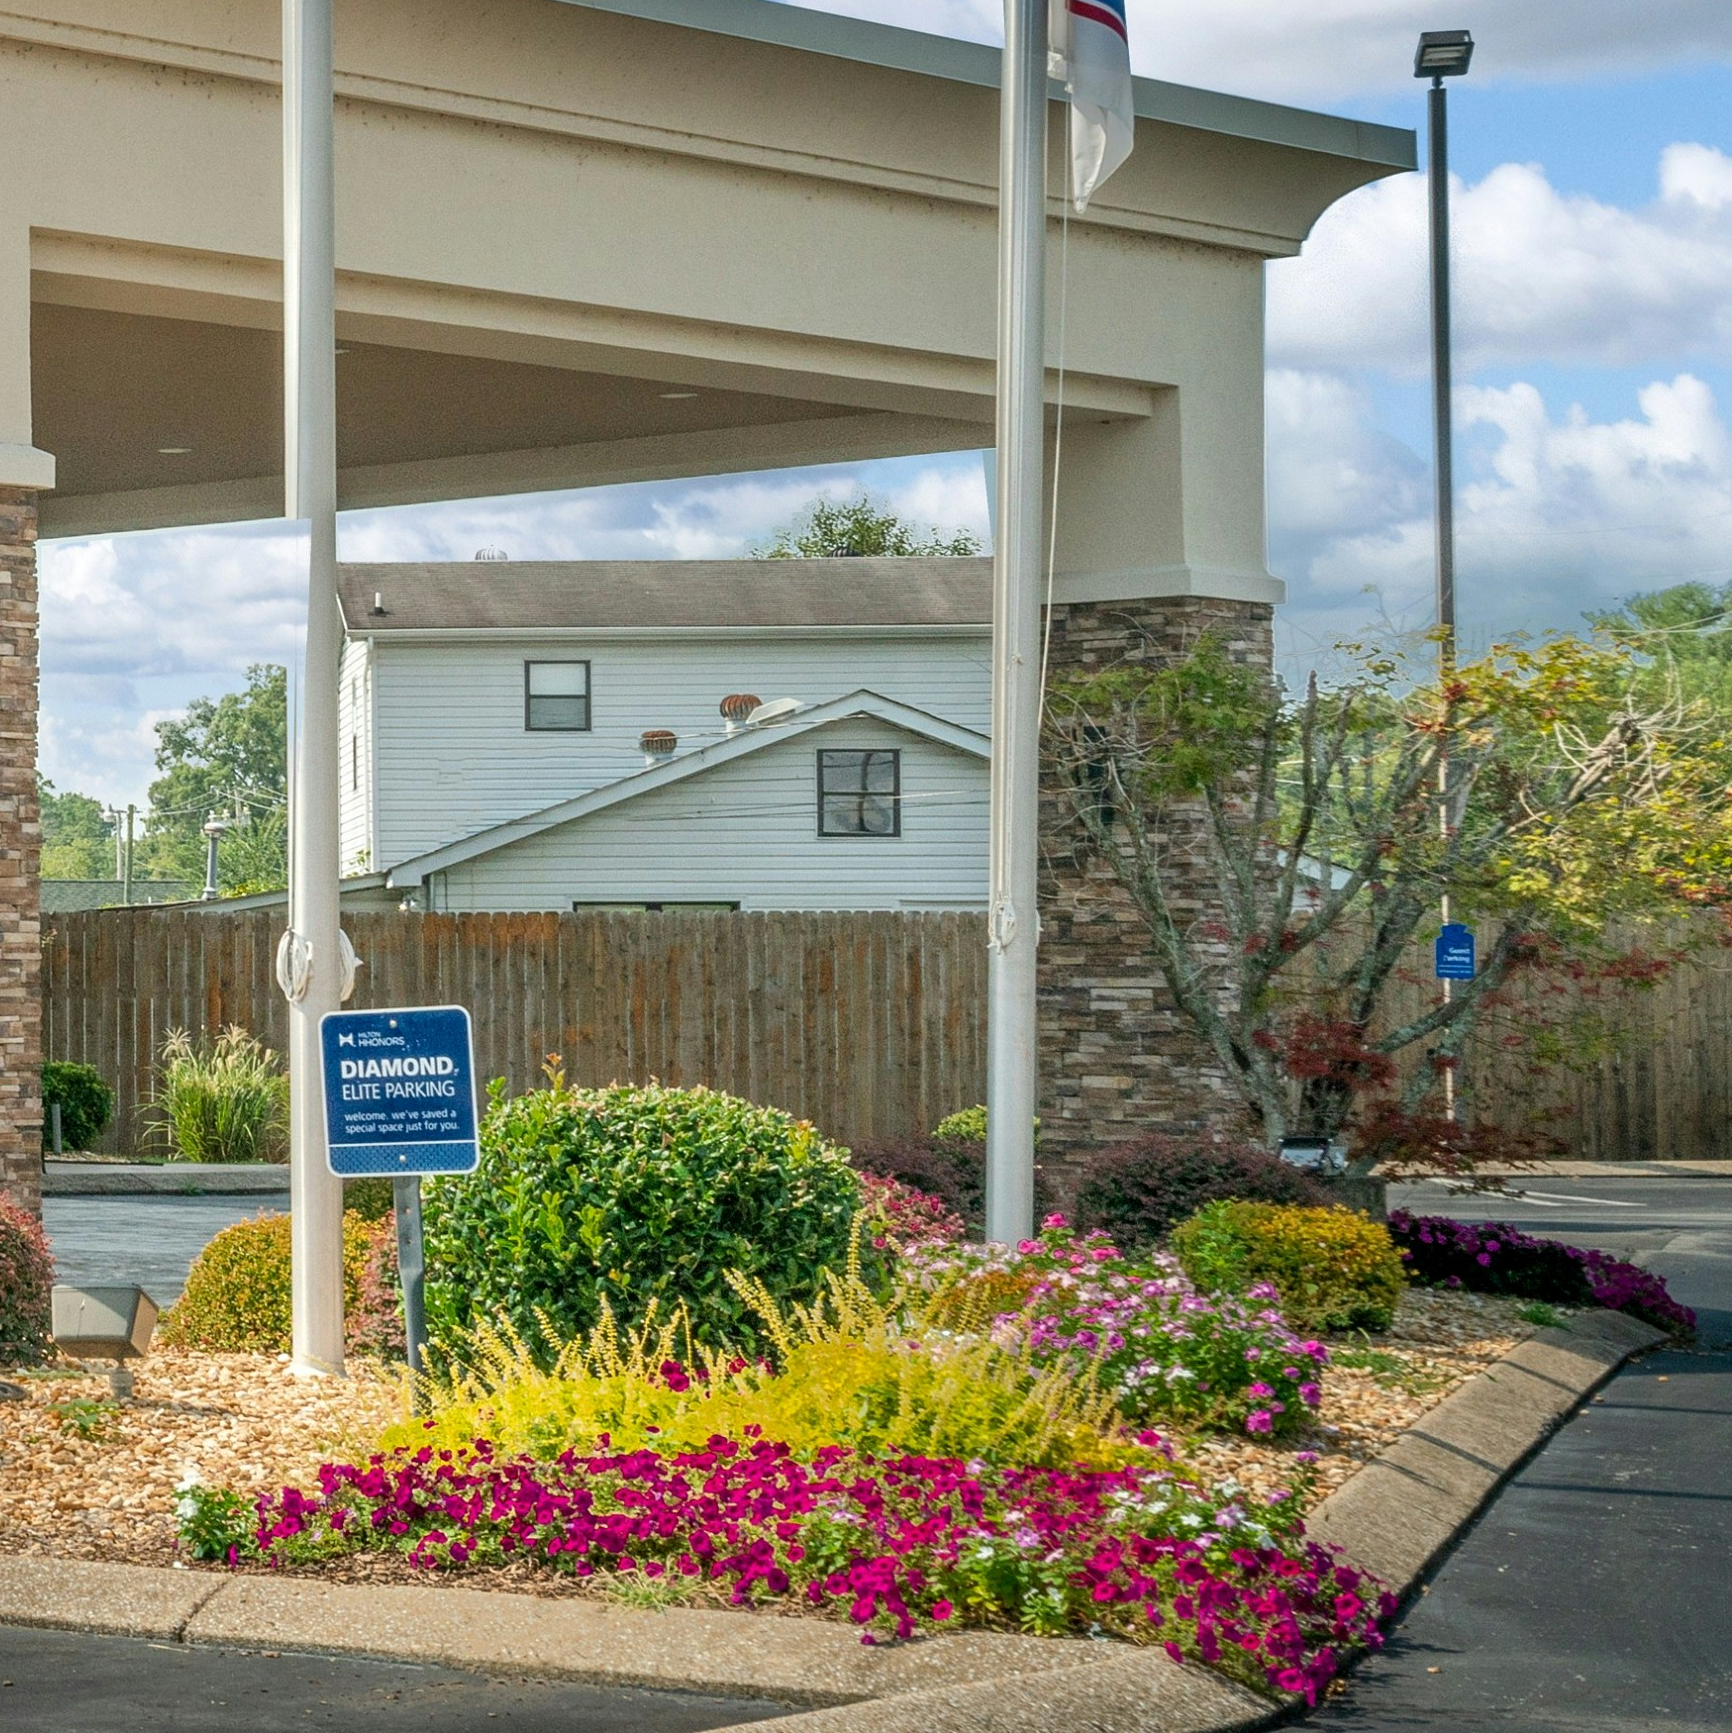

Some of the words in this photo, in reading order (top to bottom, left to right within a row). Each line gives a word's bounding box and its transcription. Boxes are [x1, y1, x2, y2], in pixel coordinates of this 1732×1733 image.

[358, 1036, 405, 1047] HHONORS
[340, 1056, 454, 1079] DIAMOND
[342, 1083, 381, 1100] ELITE
[385, 1080, 456, 1099] PARKING
[344, 1112, 389, 1121] welcome.
[391, 1110, 419, 1119] we've
[421, 1108, 448, 1118] saved
[450, 1110, 457, 1118] a
[345, 1122, 376, 1134] special
[378, 1123, 404, 1134] space
[405, 1122, 422, 1133] just
[424, 1120, 438, 1130] for
[440, 1122, 460, 1132] you.
